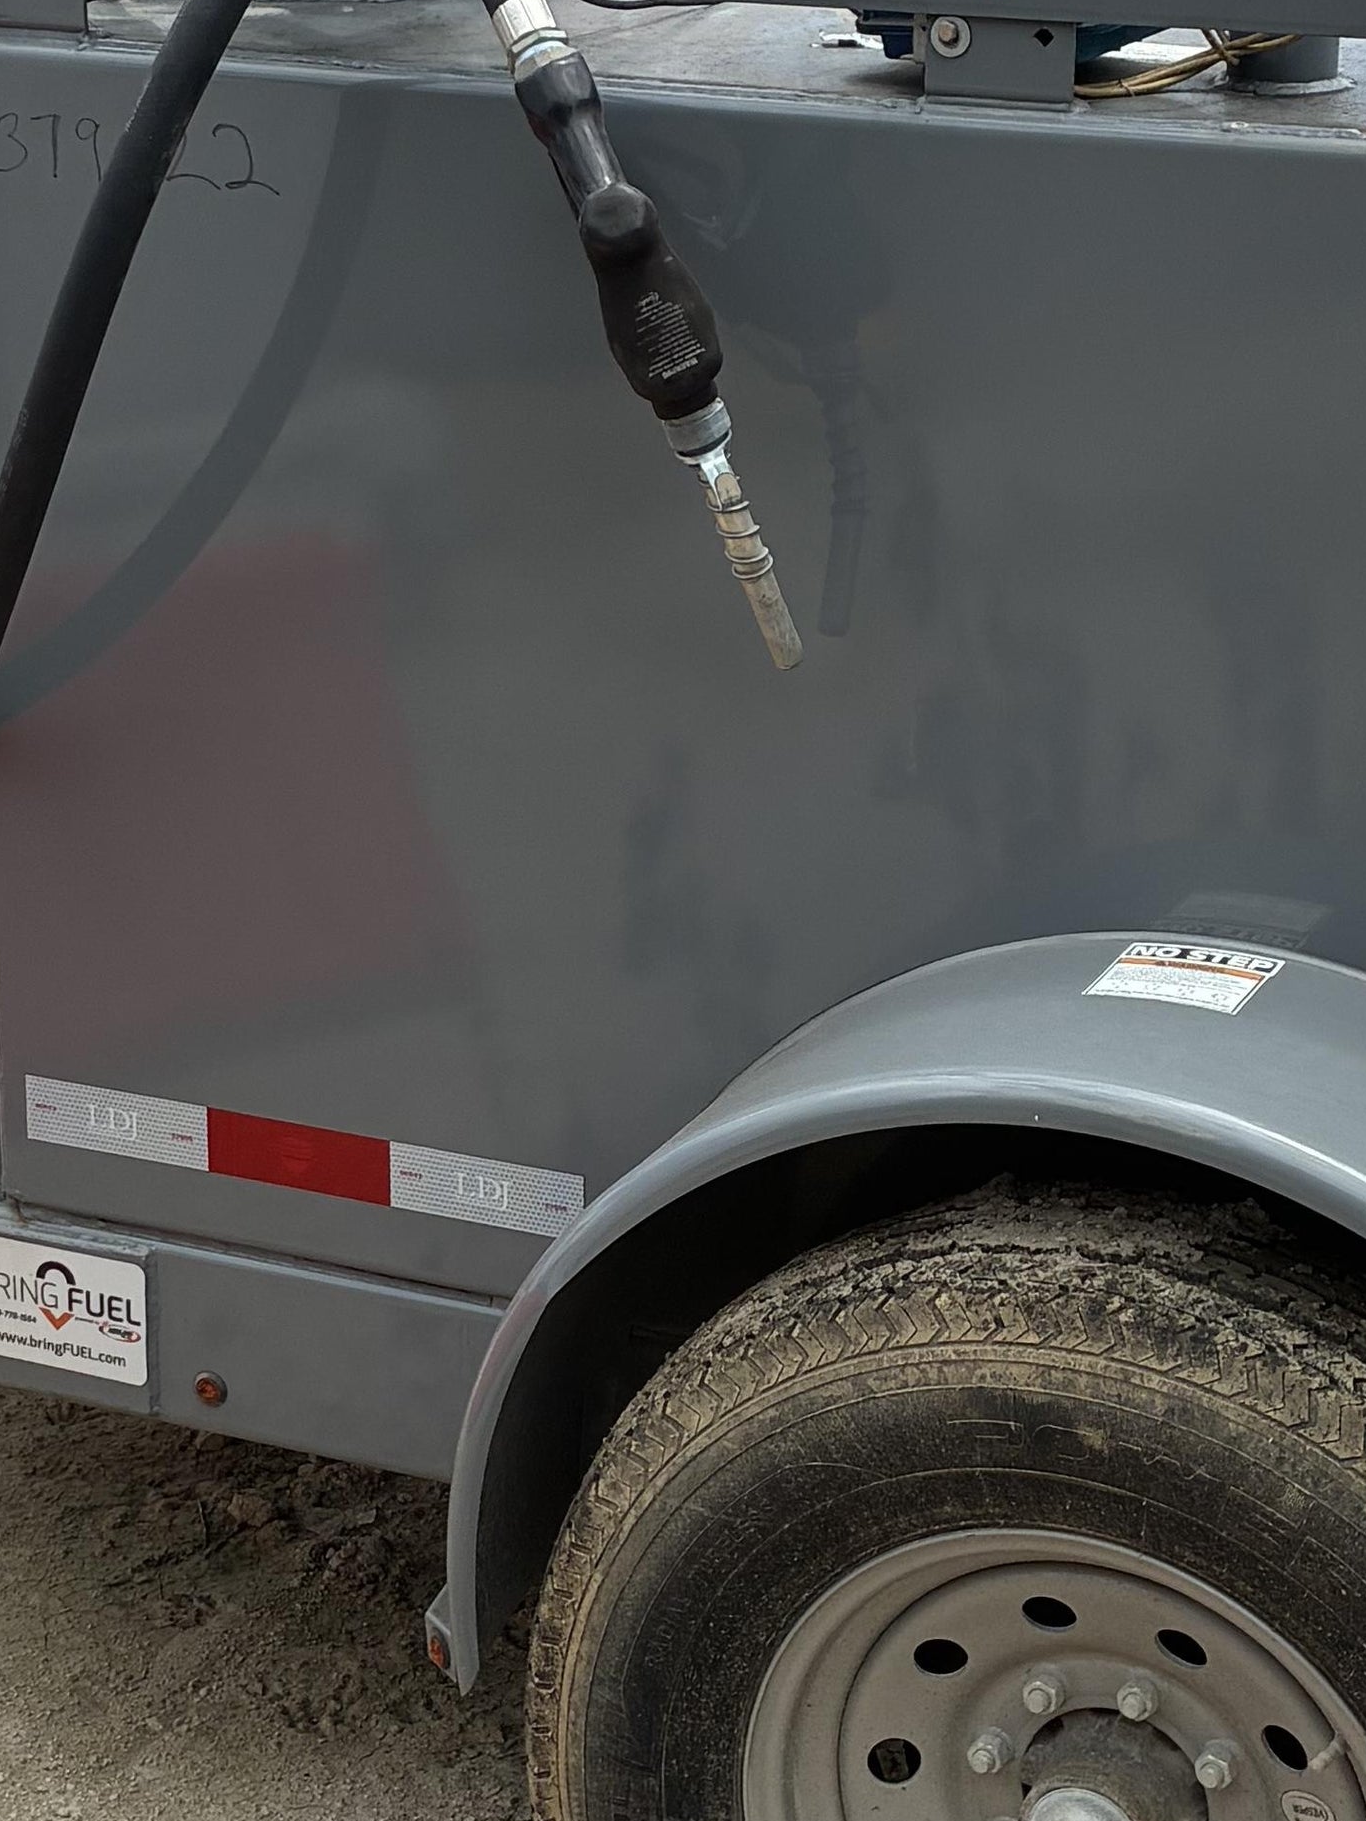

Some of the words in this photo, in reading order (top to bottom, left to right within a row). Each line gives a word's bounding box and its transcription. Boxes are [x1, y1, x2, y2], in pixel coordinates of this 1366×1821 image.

[1132, 944, 1180, 958] NO
[1186, 948, 1275, 971] STEP
[67, 1287, 142, 1327] FUEL
